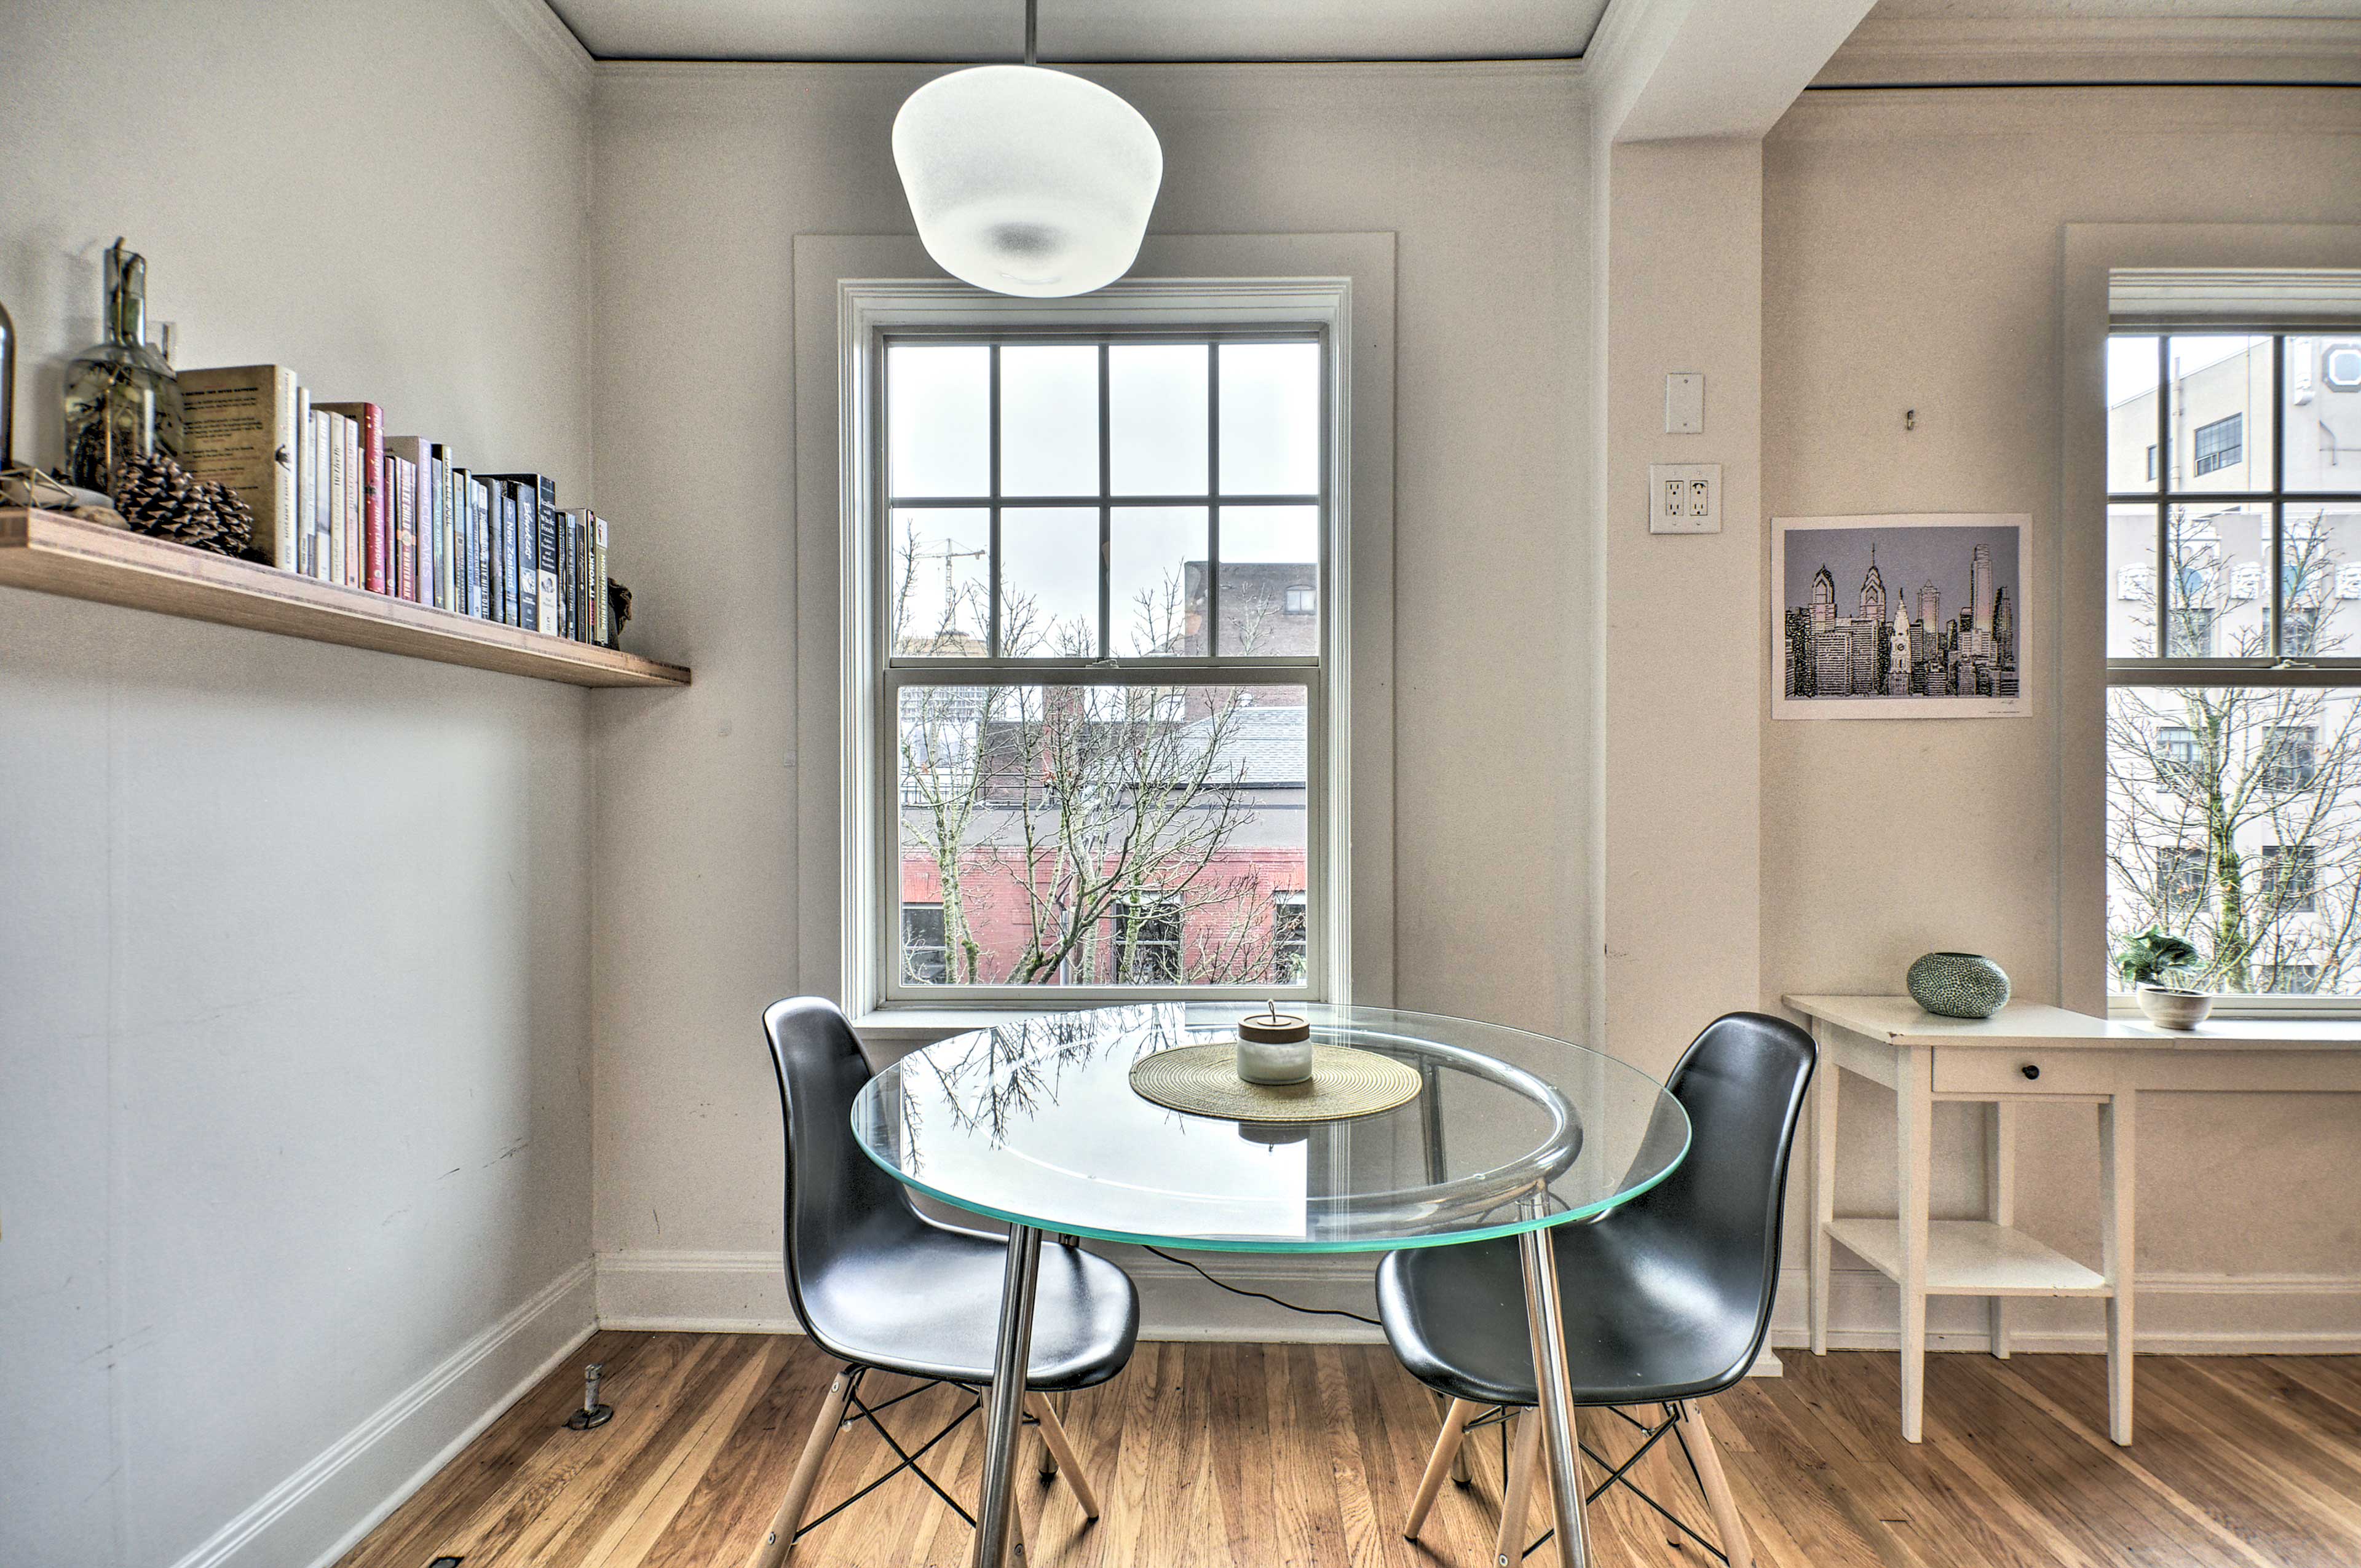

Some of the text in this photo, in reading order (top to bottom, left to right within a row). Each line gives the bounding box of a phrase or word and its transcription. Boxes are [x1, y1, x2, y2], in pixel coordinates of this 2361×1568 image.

[402, 487, 411, 529] LEE CHILD
[540, 514, 555, 526] Whole
[422, 505, 432, 578] CUPCAKES
[523, 502, 533, 560] Blankets
[540, 524, 555, 535] Foods
